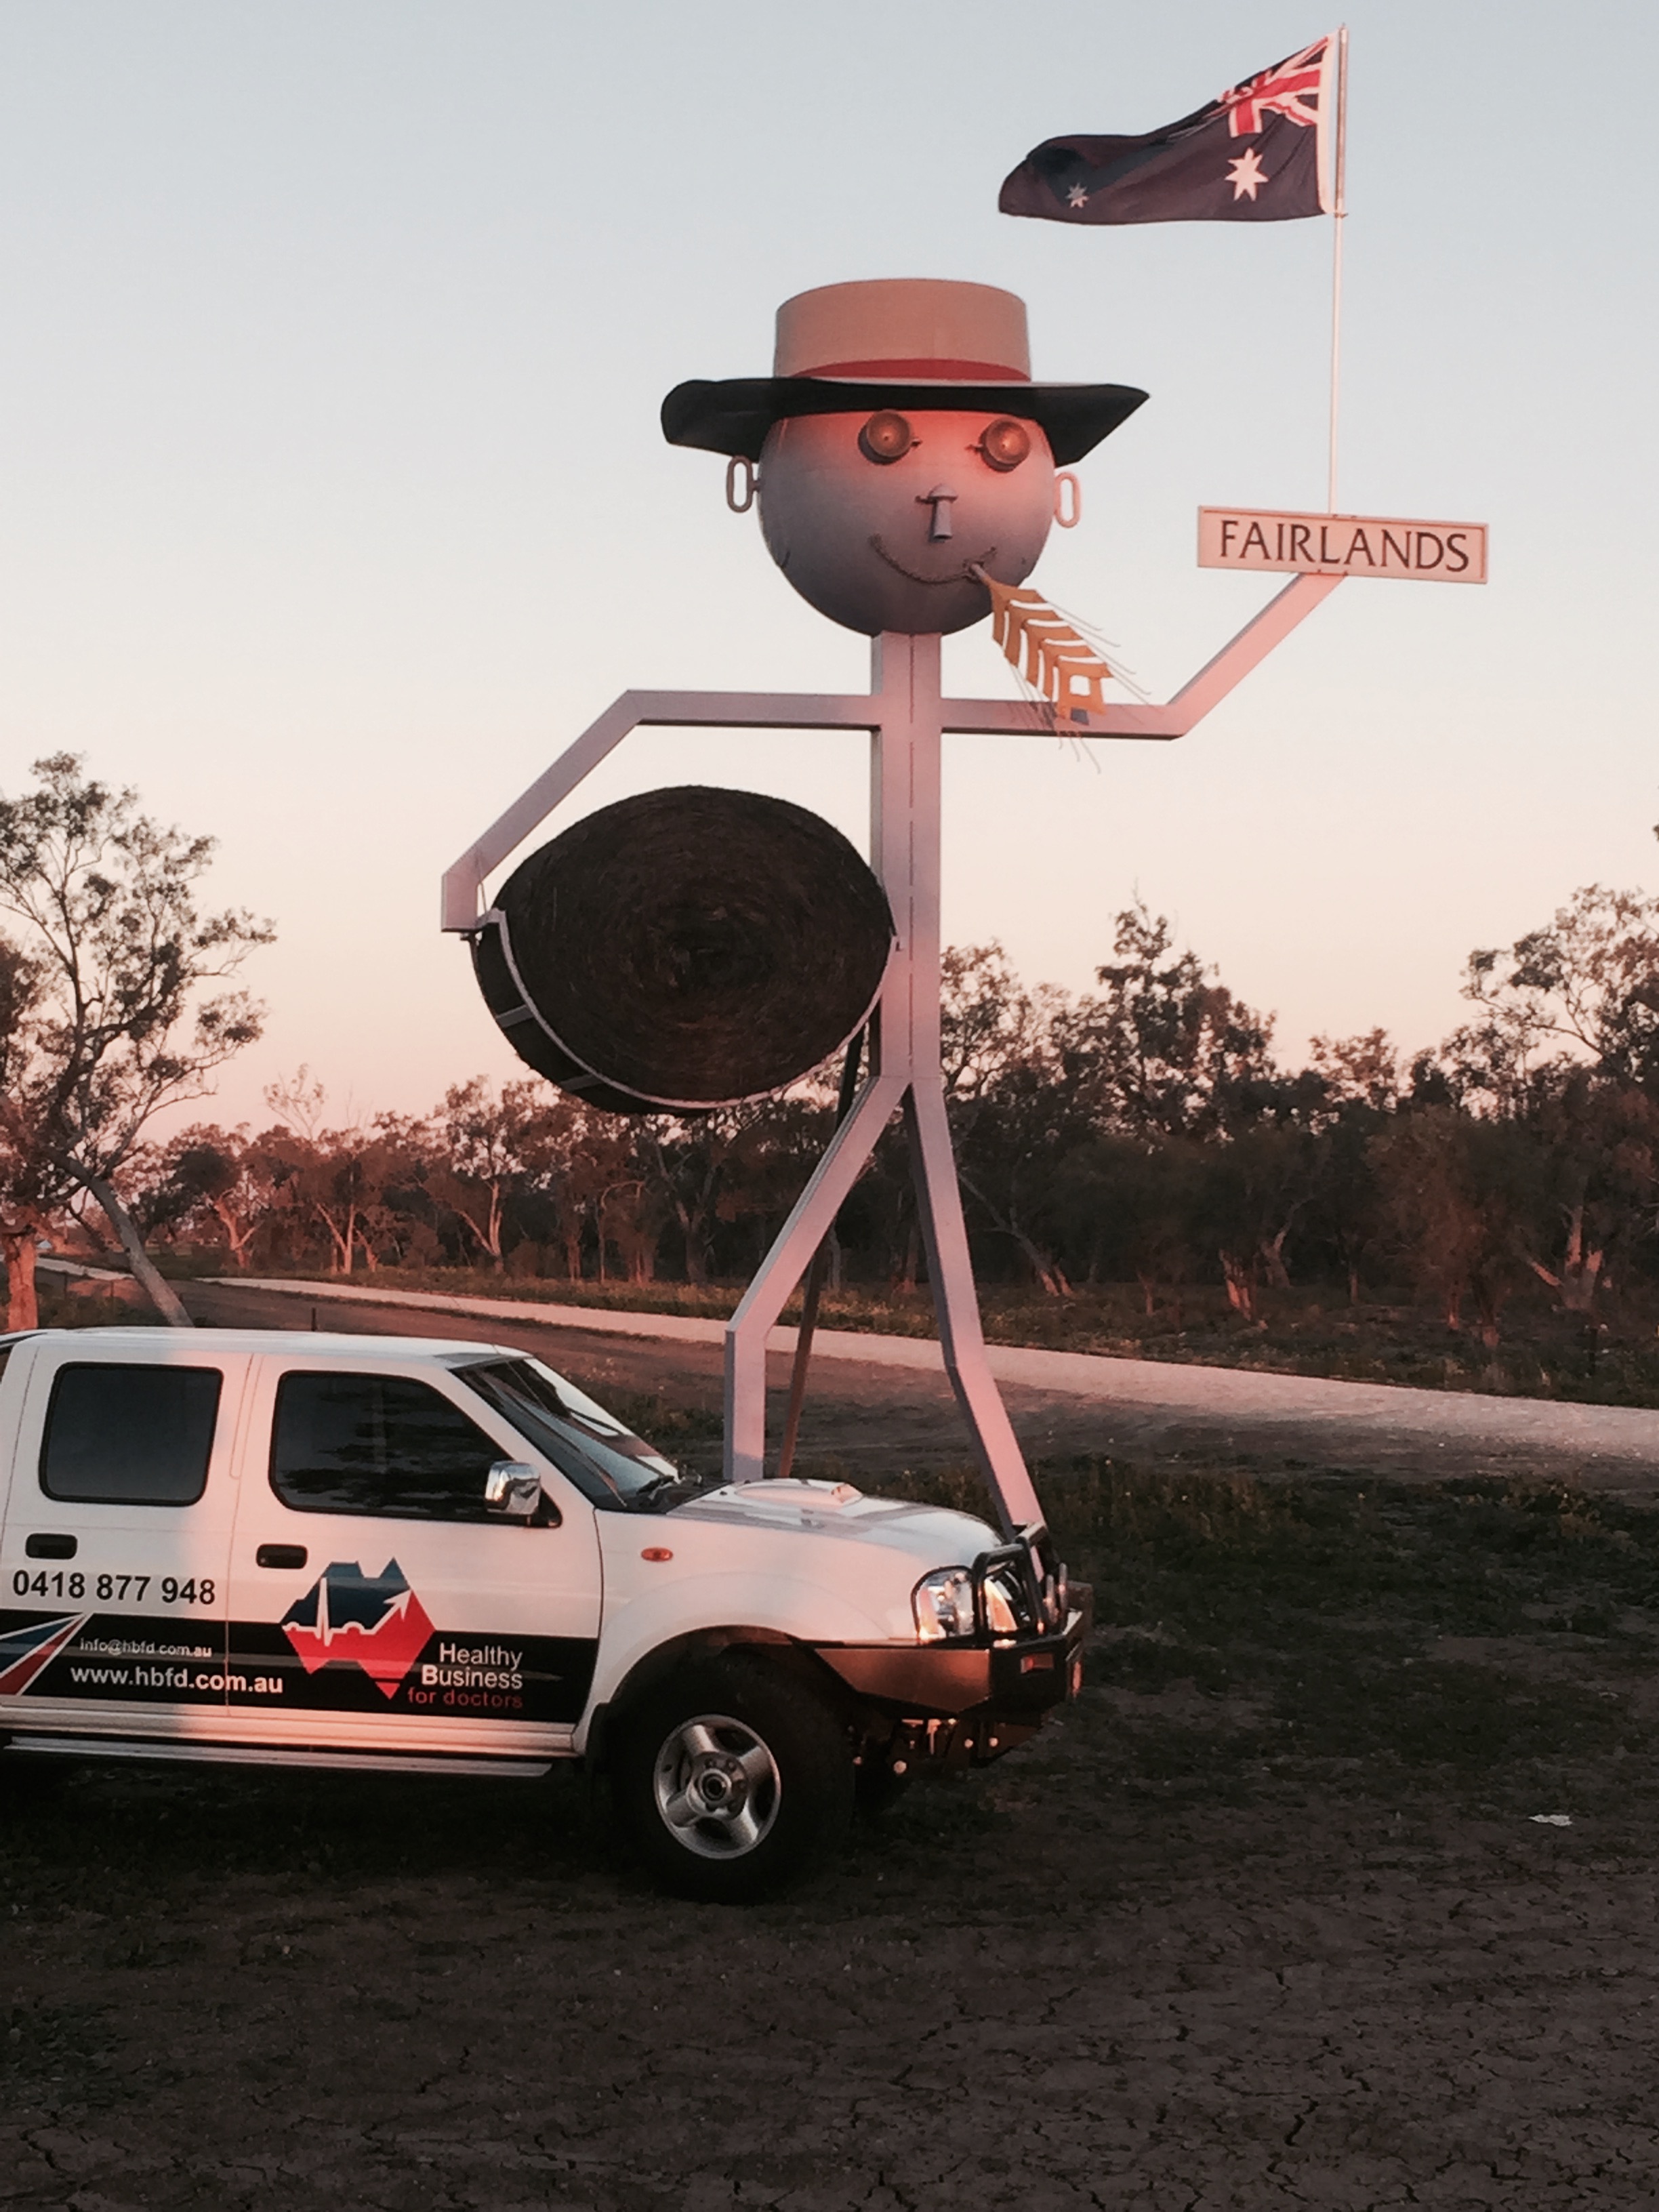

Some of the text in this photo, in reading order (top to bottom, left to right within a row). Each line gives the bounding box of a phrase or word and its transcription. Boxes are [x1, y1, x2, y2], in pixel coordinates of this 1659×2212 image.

[1220, 520, 1469, 572] FAIRLANDS
[12, 1570, 215, 1605] 0418 877 948
[80, 1637, 212, 1658] info@hbfd.com.au
[440, 1642, 523, 1671] Healthy
[70, 1666, 283, 1694] www.hbfd.com.au
[422, 1664, 523, 1689] Business
[408, 1687, 523, 1708] for doctors
